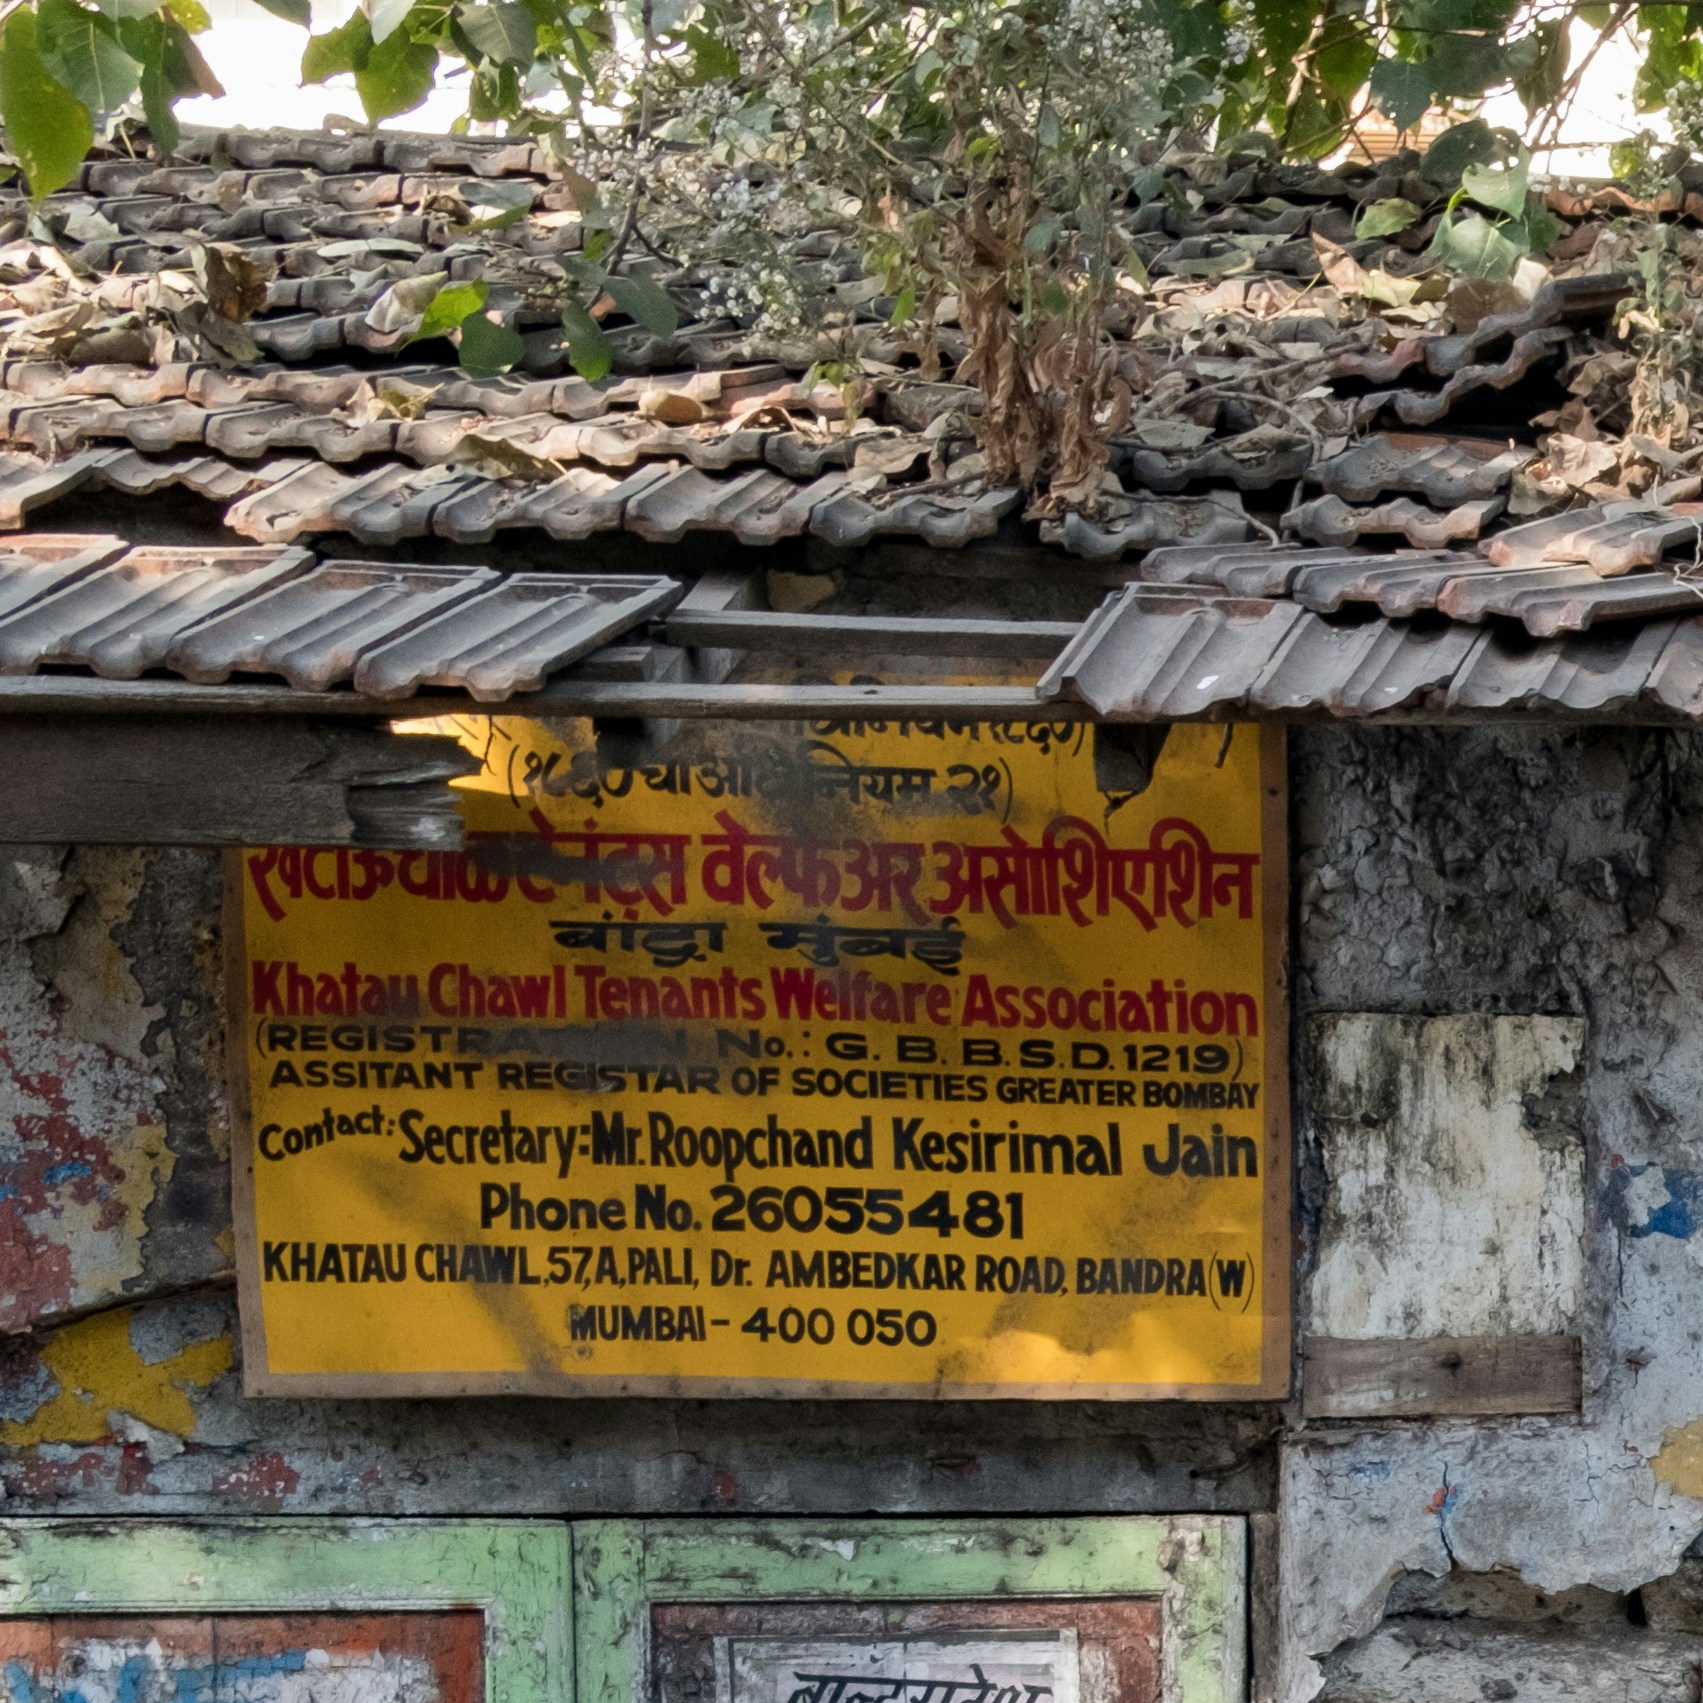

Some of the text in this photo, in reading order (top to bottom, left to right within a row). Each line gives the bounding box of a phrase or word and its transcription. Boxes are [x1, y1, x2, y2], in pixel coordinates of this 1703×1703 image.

[252, 959, 1259, 1037] Khatau Chawl Tenants Welfare Association
[269, 1060, 1260, 1111] ASSITANT REGISTAR OF SOCIETIES GREATER BOMBAY
[258, 1105, 397, 1161] Contact:
[892, 1117, 1122, 1177] Kesirimal
[1143, 1122, 1259, 1178] Jain
[480, 1182, 1025, 1240] Phone No. 26055481
[263, 1241, 407, 1283] KHATAU
[711, 1248, 753, 1288] Dr.
[765, 1249, 965, 1292] AMBEDKAR
[975, 1254, 1068, 1297] ROAD,
[742, 1307, 835, 1346] 400
[846, 1308, 938, 1347] 050
